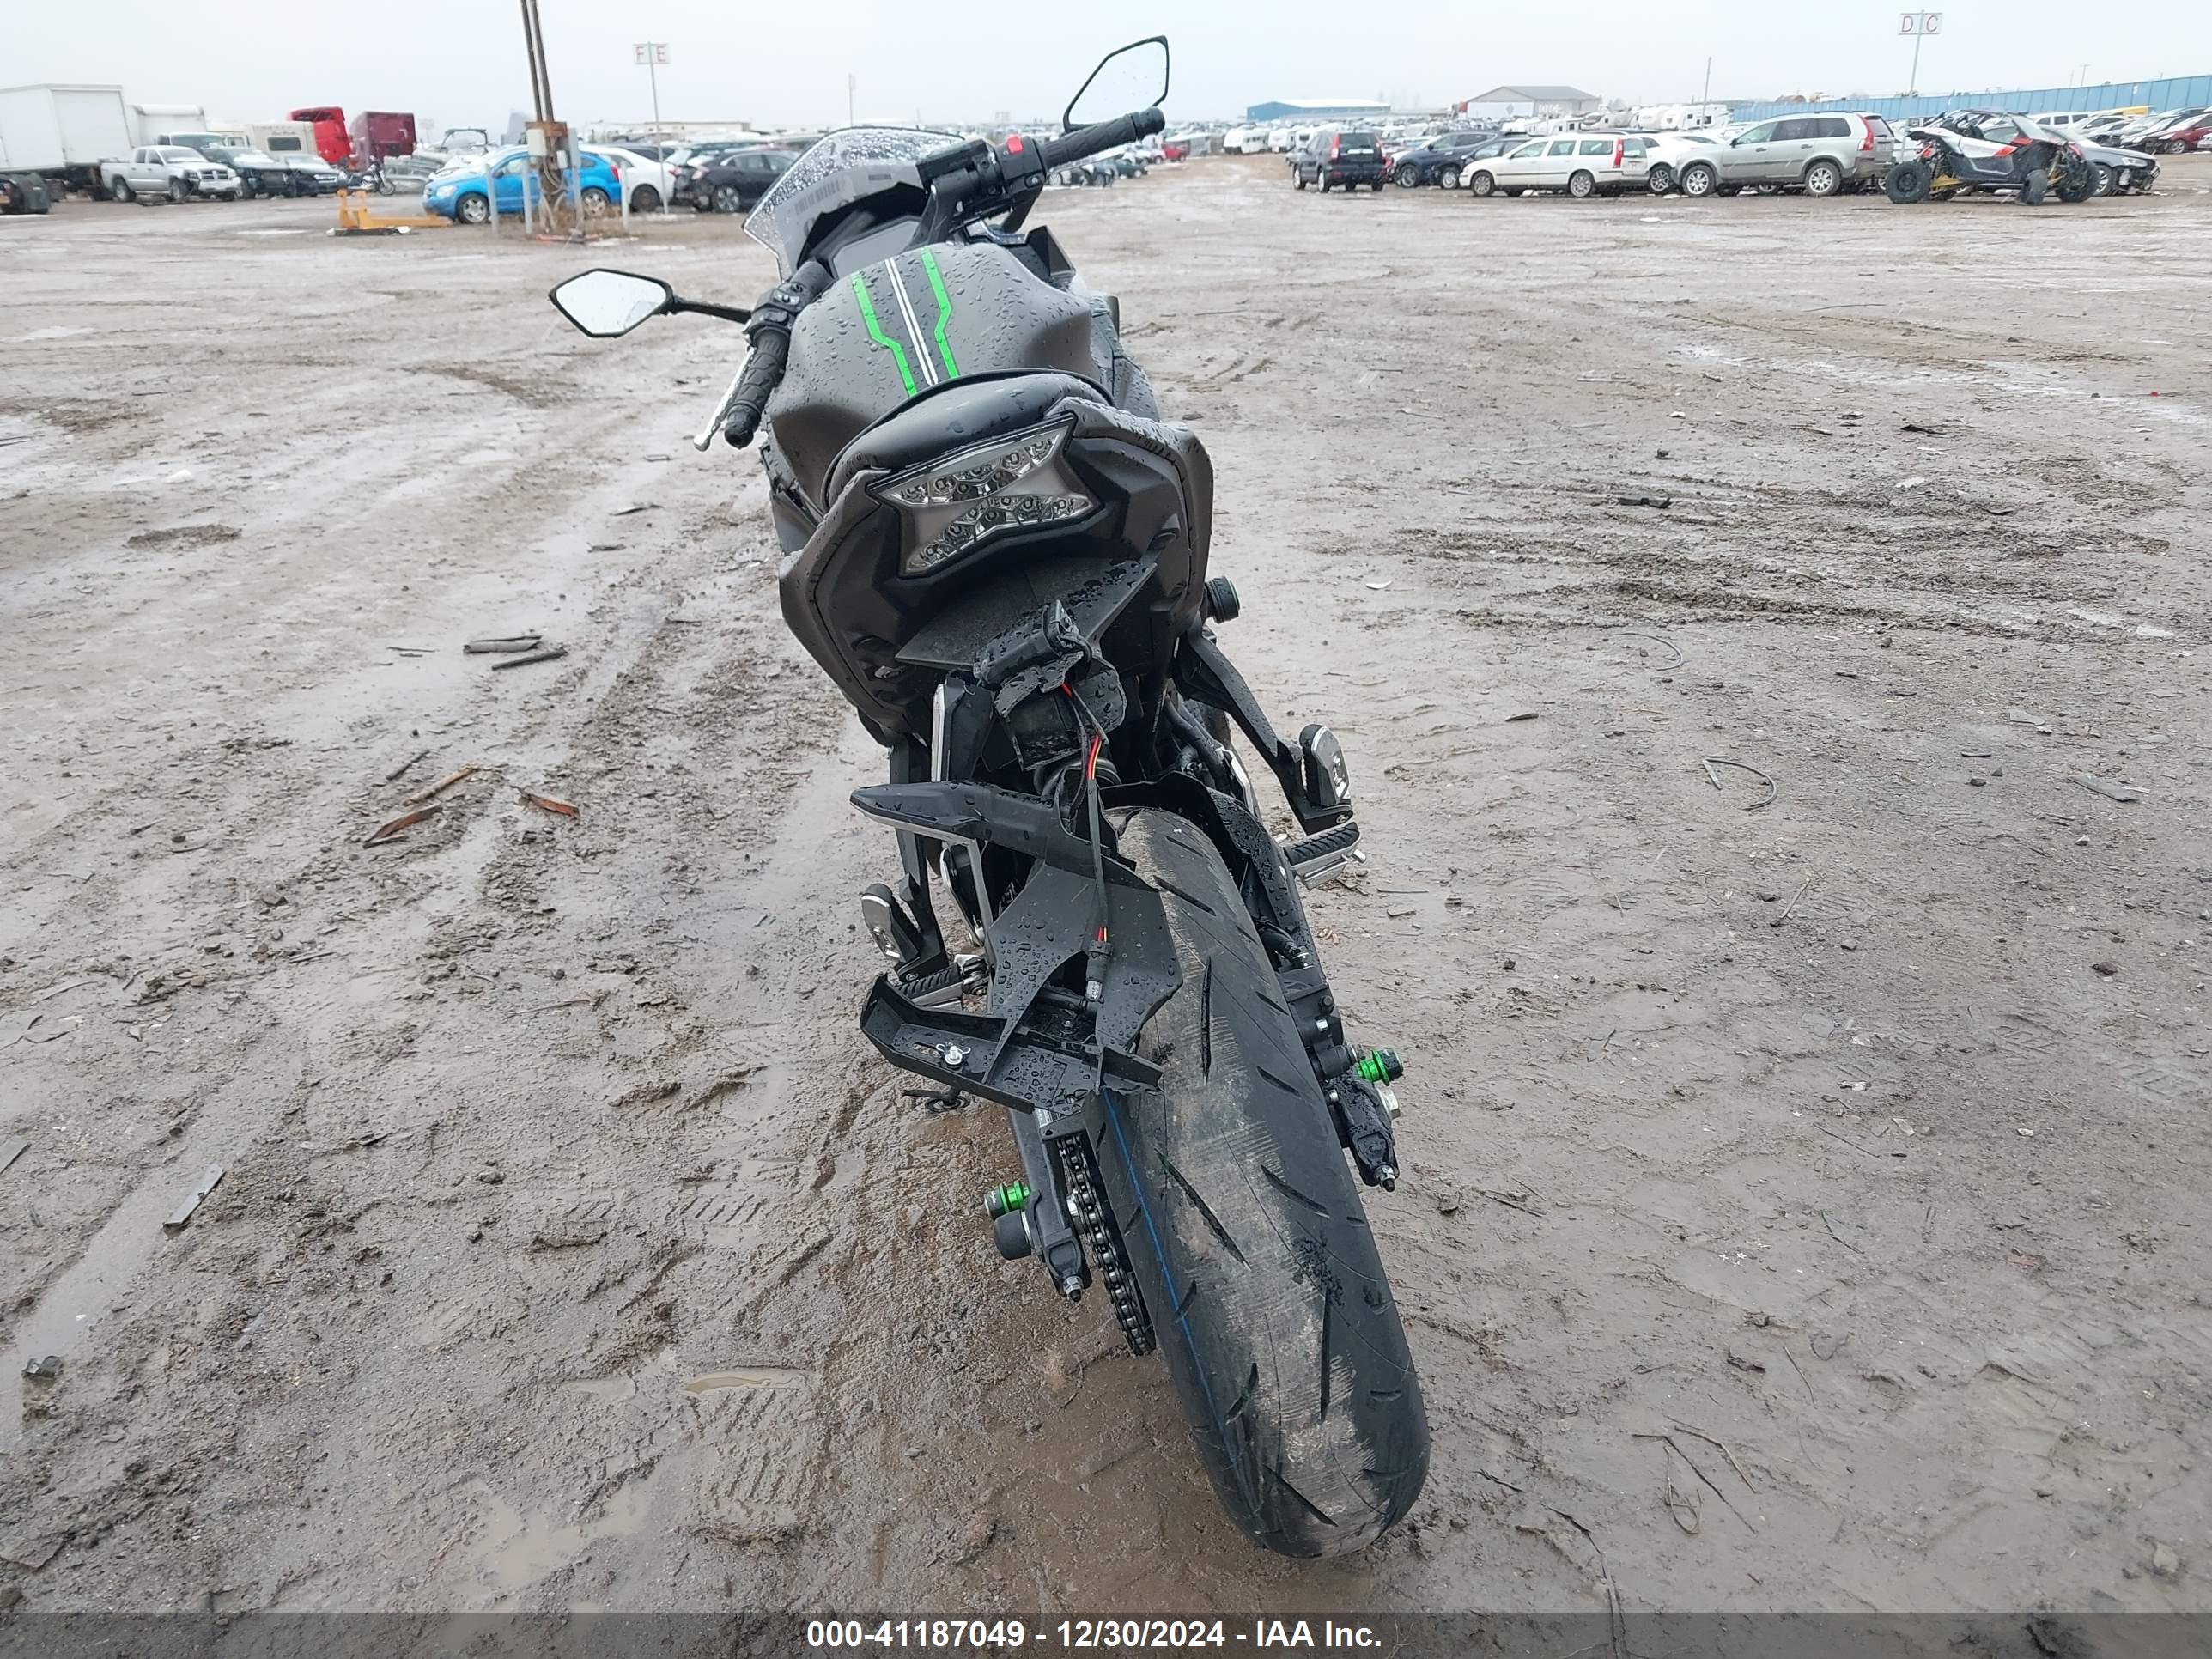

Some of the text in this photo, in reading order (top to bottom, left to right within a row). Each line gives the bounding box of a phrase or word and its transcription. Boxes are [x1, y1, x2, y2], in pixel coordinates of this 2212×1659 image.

[1901, 15, 1939, 33] D C
[635, 46, 667, 62] F E
